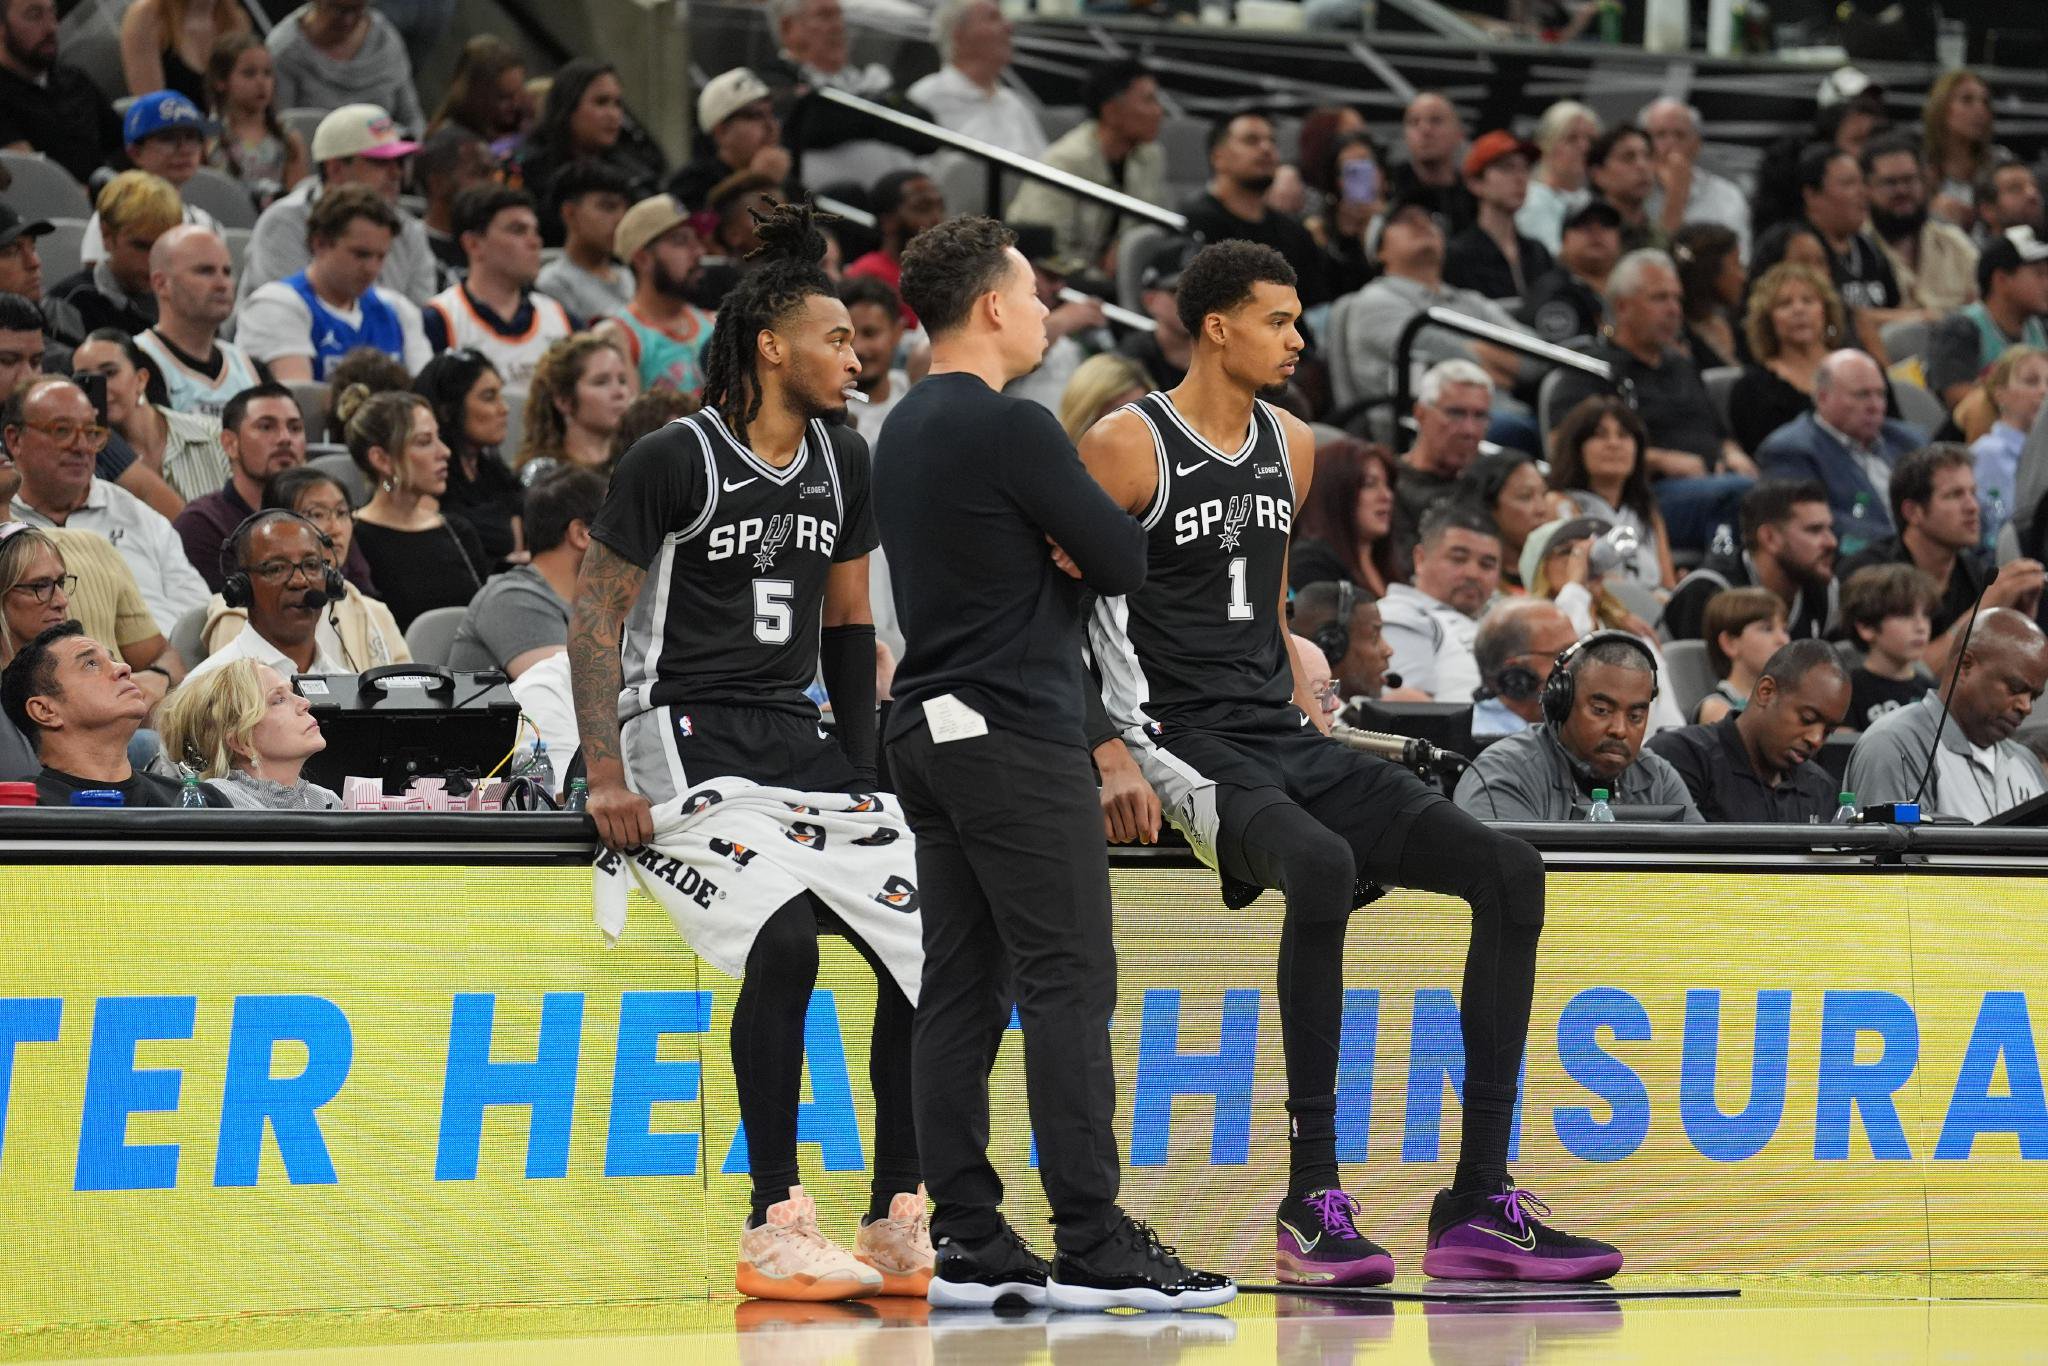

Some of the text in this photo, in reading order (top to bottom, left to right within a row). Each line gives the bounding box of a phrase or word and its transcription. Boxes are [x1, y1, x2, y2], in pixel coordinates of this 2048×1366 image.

[802, 484, 827, 495] LEDGER
[1257, 465, 1280, 475] LEDGER
[752, 578, 794, 645] 5
[1227, 557, 1254, 621] 1
[624, 845, 719, 910] RADE
[434, 988, 1261, 1181] HEAH
